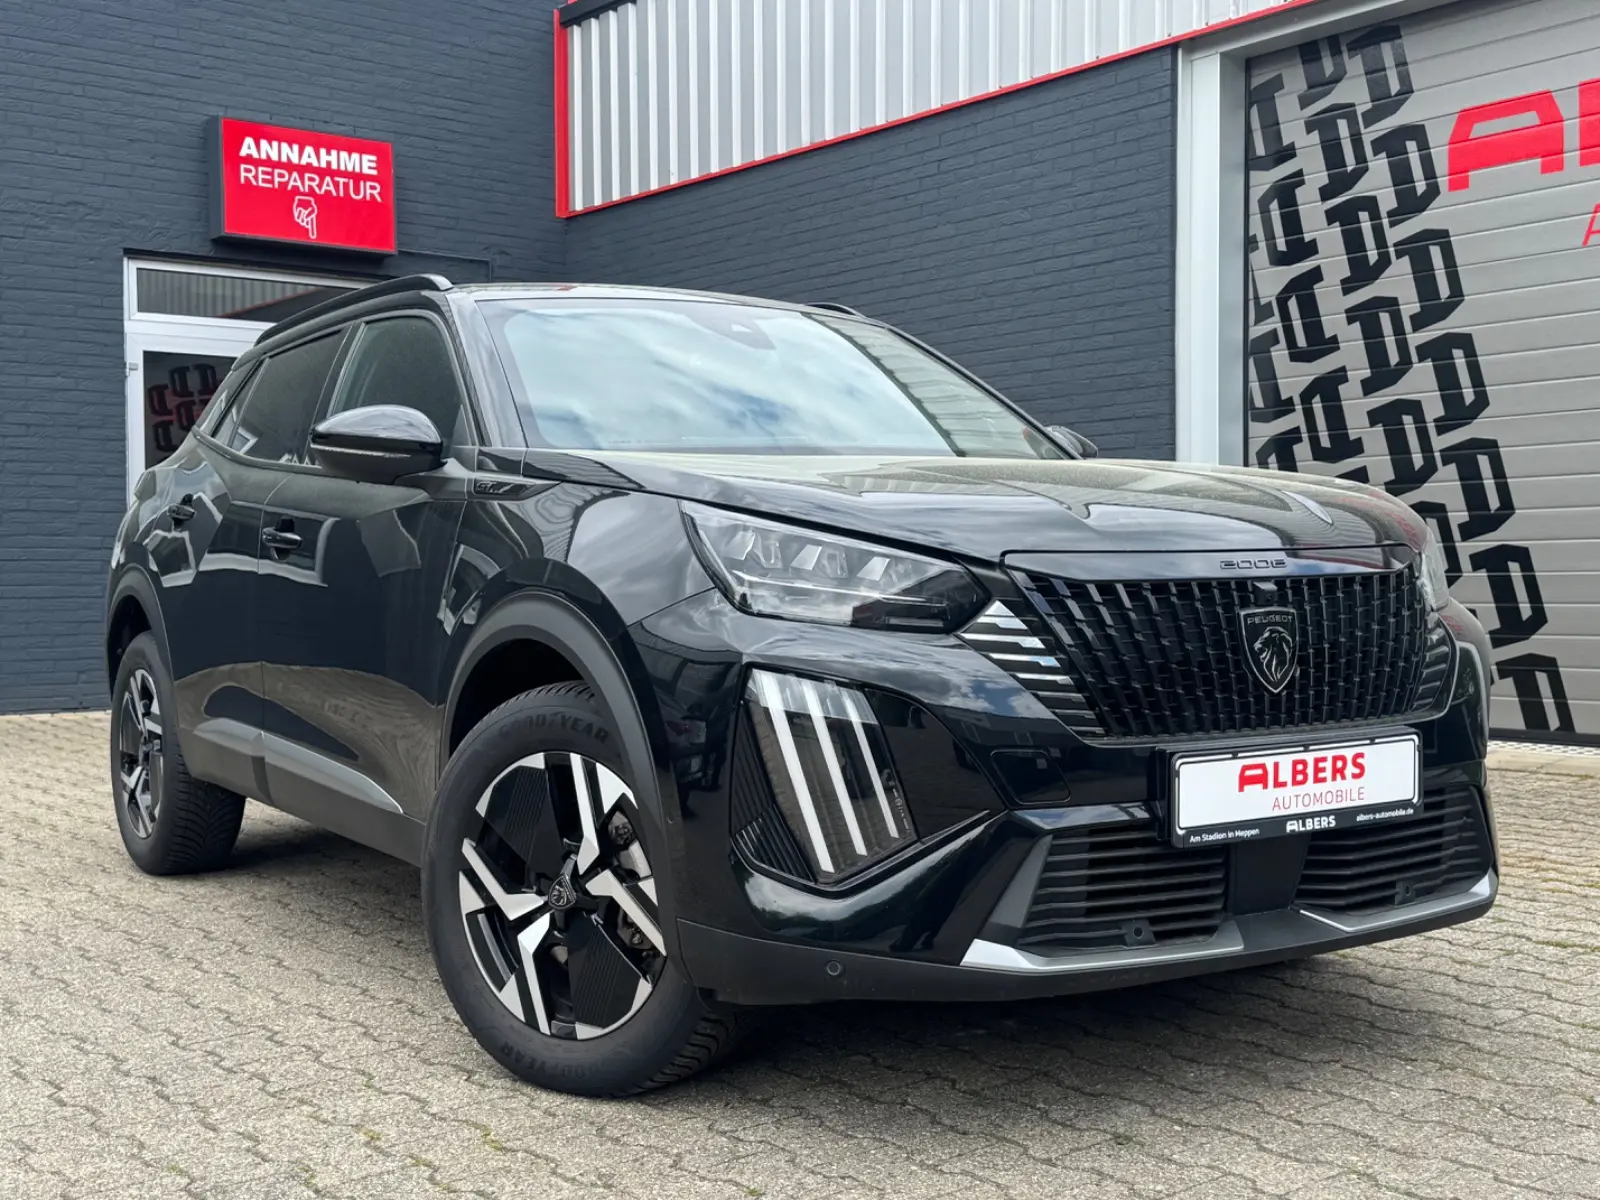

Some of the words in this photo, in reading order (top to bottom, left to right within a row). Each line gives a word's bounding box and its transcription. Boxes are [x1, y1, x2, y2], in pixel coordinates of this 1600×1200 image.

[239, 136, 378, 175] ANNAHME
[239, 163, 382, 202] REPARATUR
[1220, 559, 1287, 570] 2008
[1247, 614, 1293, 625] PEUGEOT
[1238, 752, 1366, 792] ALBERS
[1272, 786, 1365, 812] AUTOMOBILE
[1356, 807, 1414, 821] albers-automobile.de
[1286, 815, 1336, 833] ALBERS
[1189, 835, 1201, 843] Am
[1202, 832, 1227, 842] Stadion
[1228, 830, 1235, 839] in
